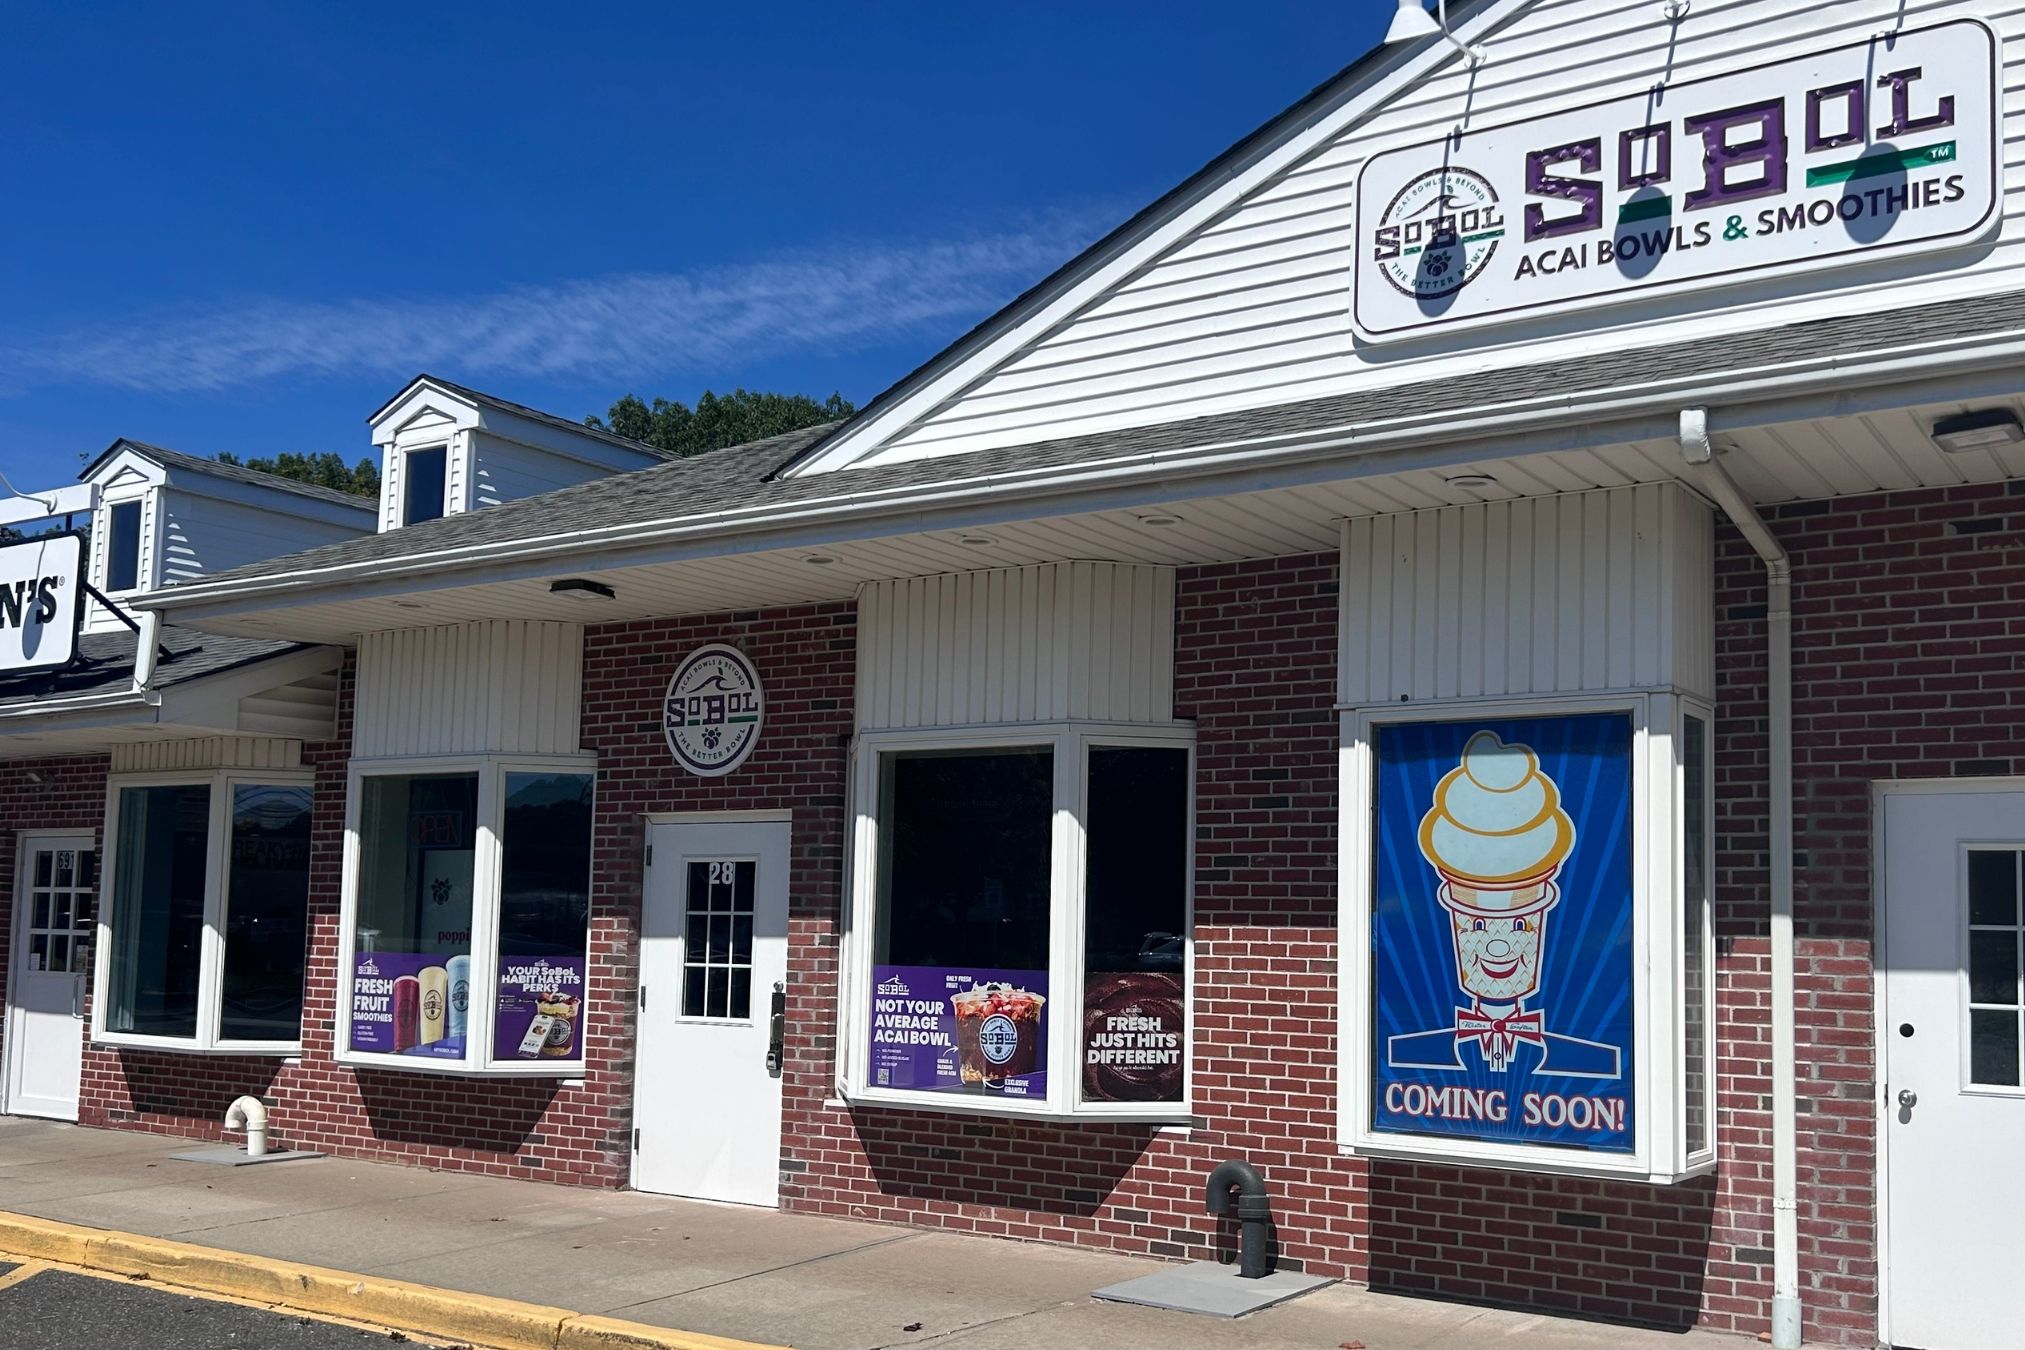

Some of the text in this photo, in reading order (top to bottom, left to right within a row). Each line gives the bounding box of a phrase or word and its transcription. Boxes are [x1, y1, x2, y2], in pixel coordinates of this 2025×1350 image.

[1455, 177, 1486, 201] BEYOND
[1514, 173, 1966, 281] ACAI BOWLS & SMOOTHIES
[1391, 246, 1487, 289] THE BETTER BOWL
[681, 672, 693, 691] ACAI
[694, 659, 716, 672] BOWLS
[724, 660, 745, 686] BEYOND
[678, 728, 746, 760] THE BETTER BOWL
[710, 862, 734, 885] 28
[508, 966, 539, 976] YOUR
[354, 978, 393, 995] FRESH
[501, 975, 581, 985] HABIT HAS ITS
[522, 983, 559, 992] PERKS
[354, 995, 390, 1012] FRUIT
[875, 999, 945, 1015] NOT YOUR
[353, 1012, 393, 1023] SMOOTHIES
[874, 1014, 939, 1030] AVERAGE
[1106, 1016, 1161, 1031] FRESH
[874, 1029, 952, 1047] ACAI BOWL
[1090, 1033, 1177, 1048] JUST HITS
[1087, 1049, 1180, 1064] DIFFERENT
[1385, 1082, 1625, 1131] COMING SOON!
